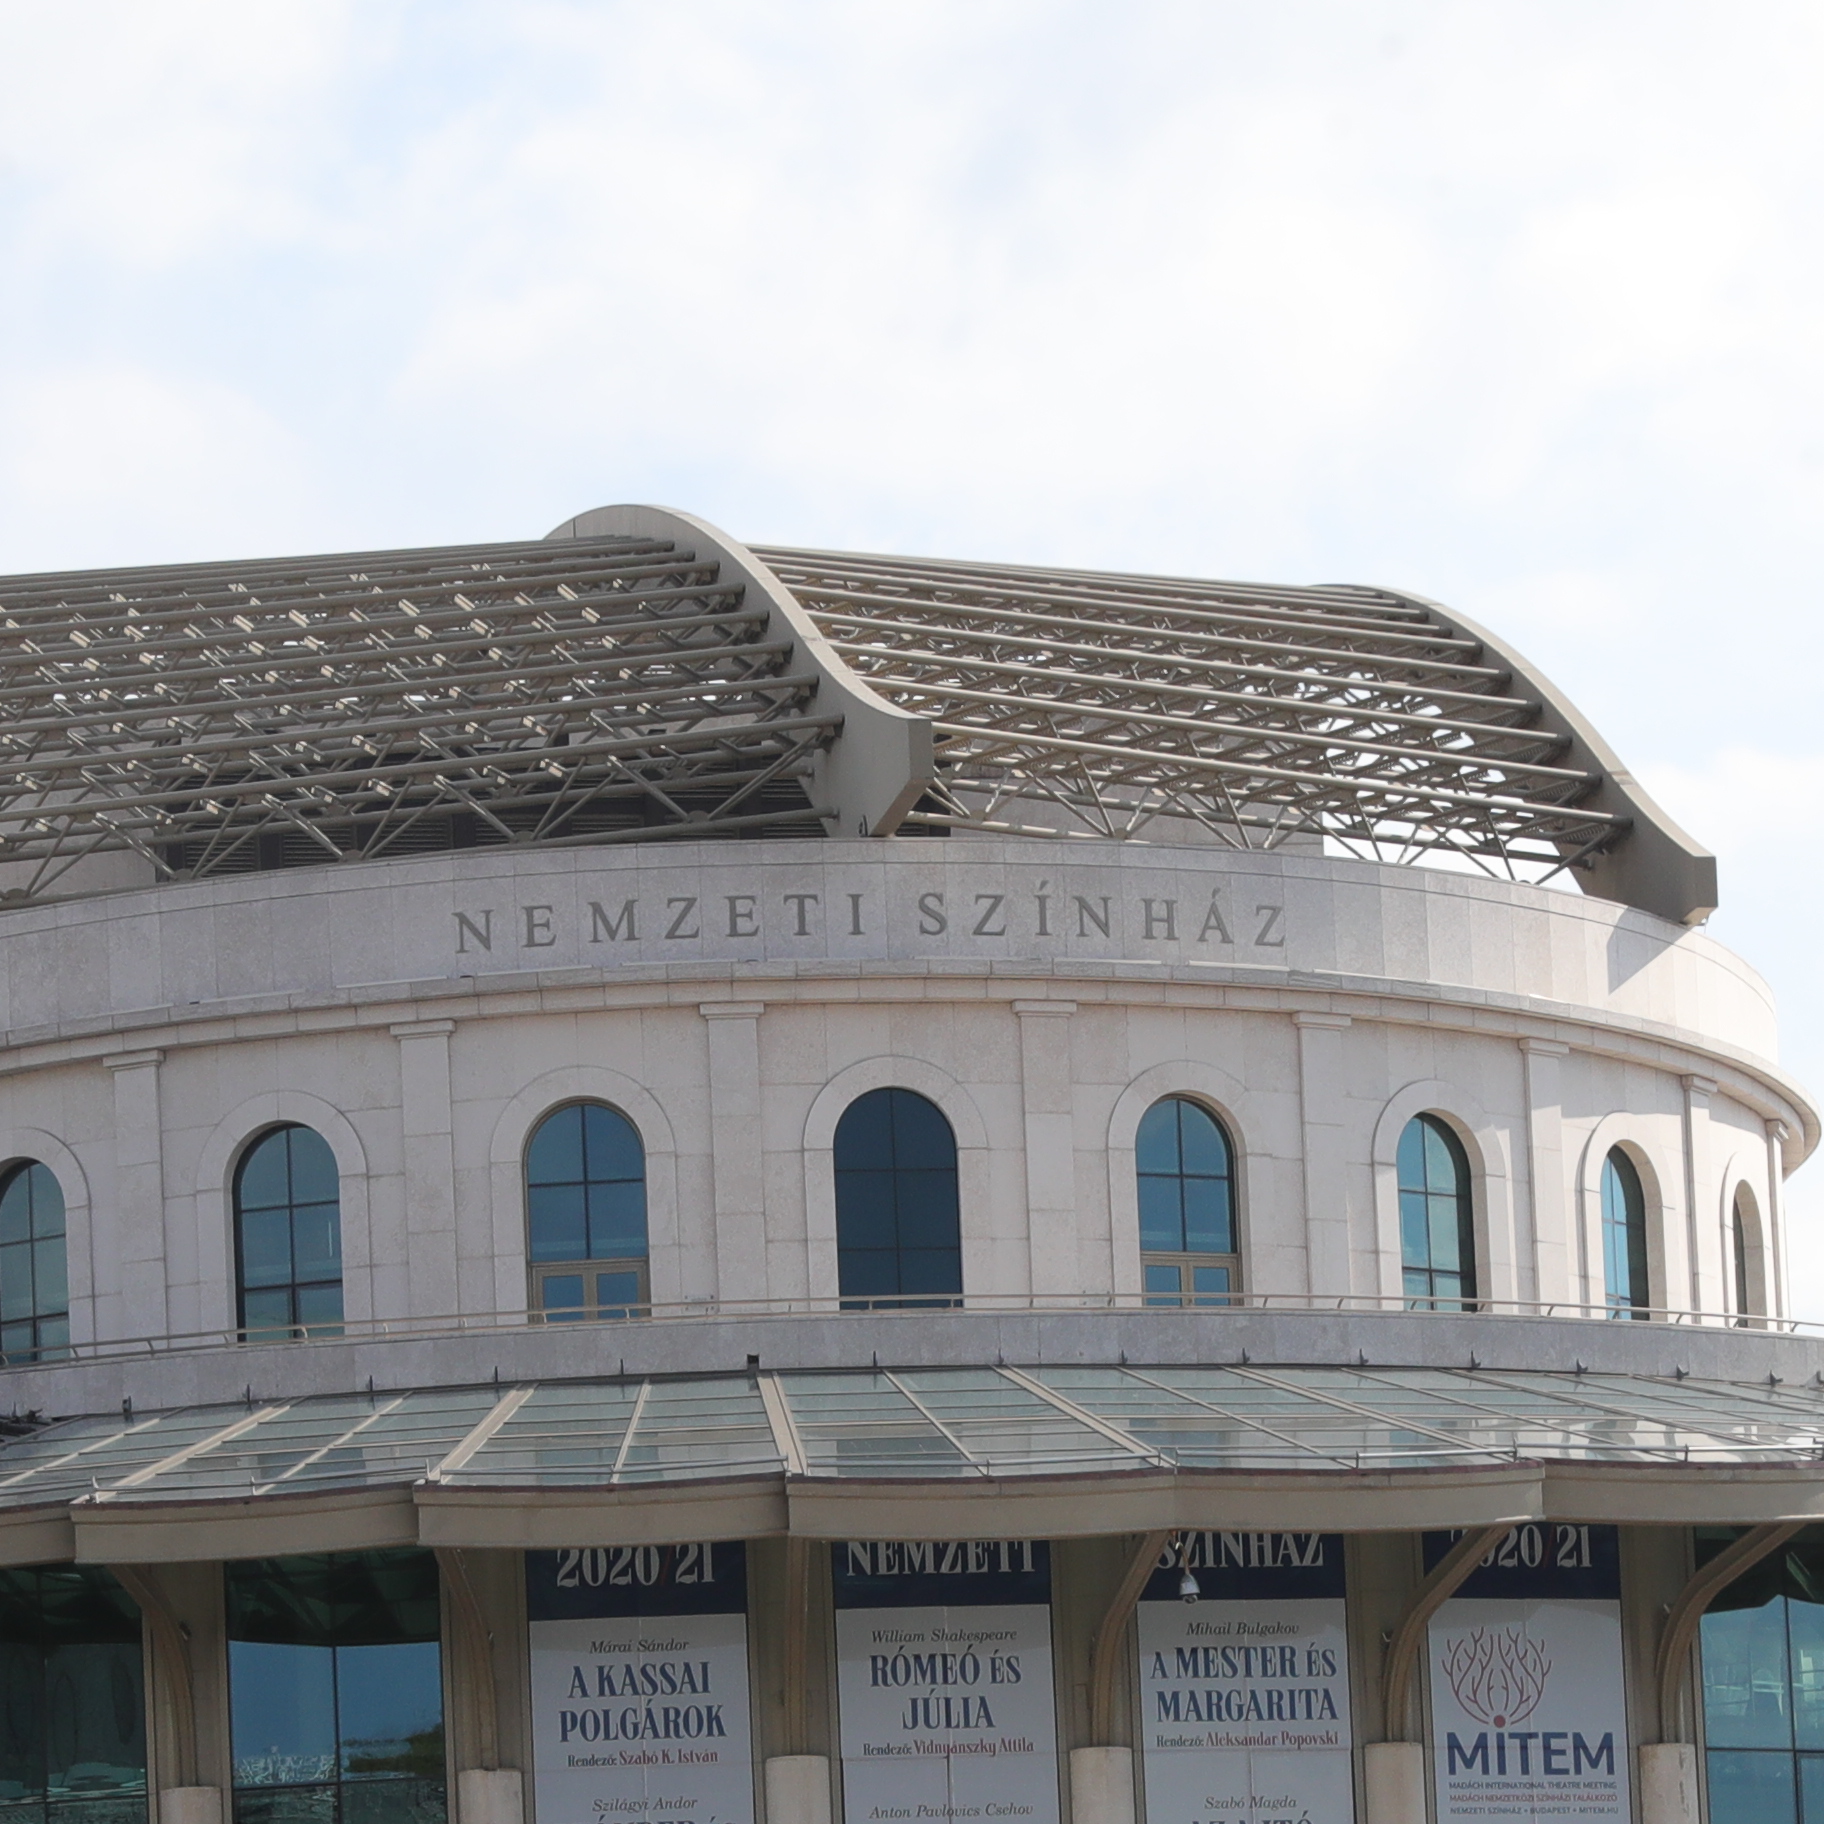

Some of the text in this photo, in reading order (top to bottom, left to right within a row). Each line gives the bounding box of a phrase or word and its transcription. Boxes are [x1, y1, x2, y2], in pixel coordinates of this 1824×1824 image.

[452, 880, 1286, 953] NEMZETI SZÍNHÁZ
[847, 1541, 1035, 1576] NEMZETI
[872, 1628, 1017, 1644] William Shakespeare
[1186, 1621, 1299, 1637] Mihail Bulgakov
[590, 1639, 689, 1654] Márai Sándor
[870, 1644, 1021, 1688] RÓMEÓ ÉS
[1150, 1642, 1337, 1679] A MESTER ÉS
[568, 1662, 711, 1698] A KASSAI
[902, 1689, 995, 1730] JÚLIA
[1156, 1688, 1339, 1723] MARGARITA
[559, 1699, 727, 1742] POLGÁROK
[913, 1737, 996, 1757] Vidnyánszky
[999, 1737, 1034, 1752] Attila
[1206, 1731, 1277, 1746] Aleksandar
[1280, 1730, 1338, 1750] Popovski
[619, 1750, 658, 1765] Szabó
[662, 1749, 675, 1764] K.
[678, 1748, 718, 1763] István
[1447, 1732, 1614, 1776] MITEM
[1449, 1781, 1617, 1790] MADÁCH INTERNATIONAL THEATRE MEETING
[592, 1796, 698, 1813] Szilágyi Andor
[869, 1802, 1033, 1819] Anton Pavlovics Csehov
[1205, 1795, 1297, 1811] Szabó Magda
[1450, 1807, 1485, 1815] NEMZETI
[1530, 1806, 1571, 1815] BUDAPEST
[1579, 1805, 1619, 1814] MITEM.HU
